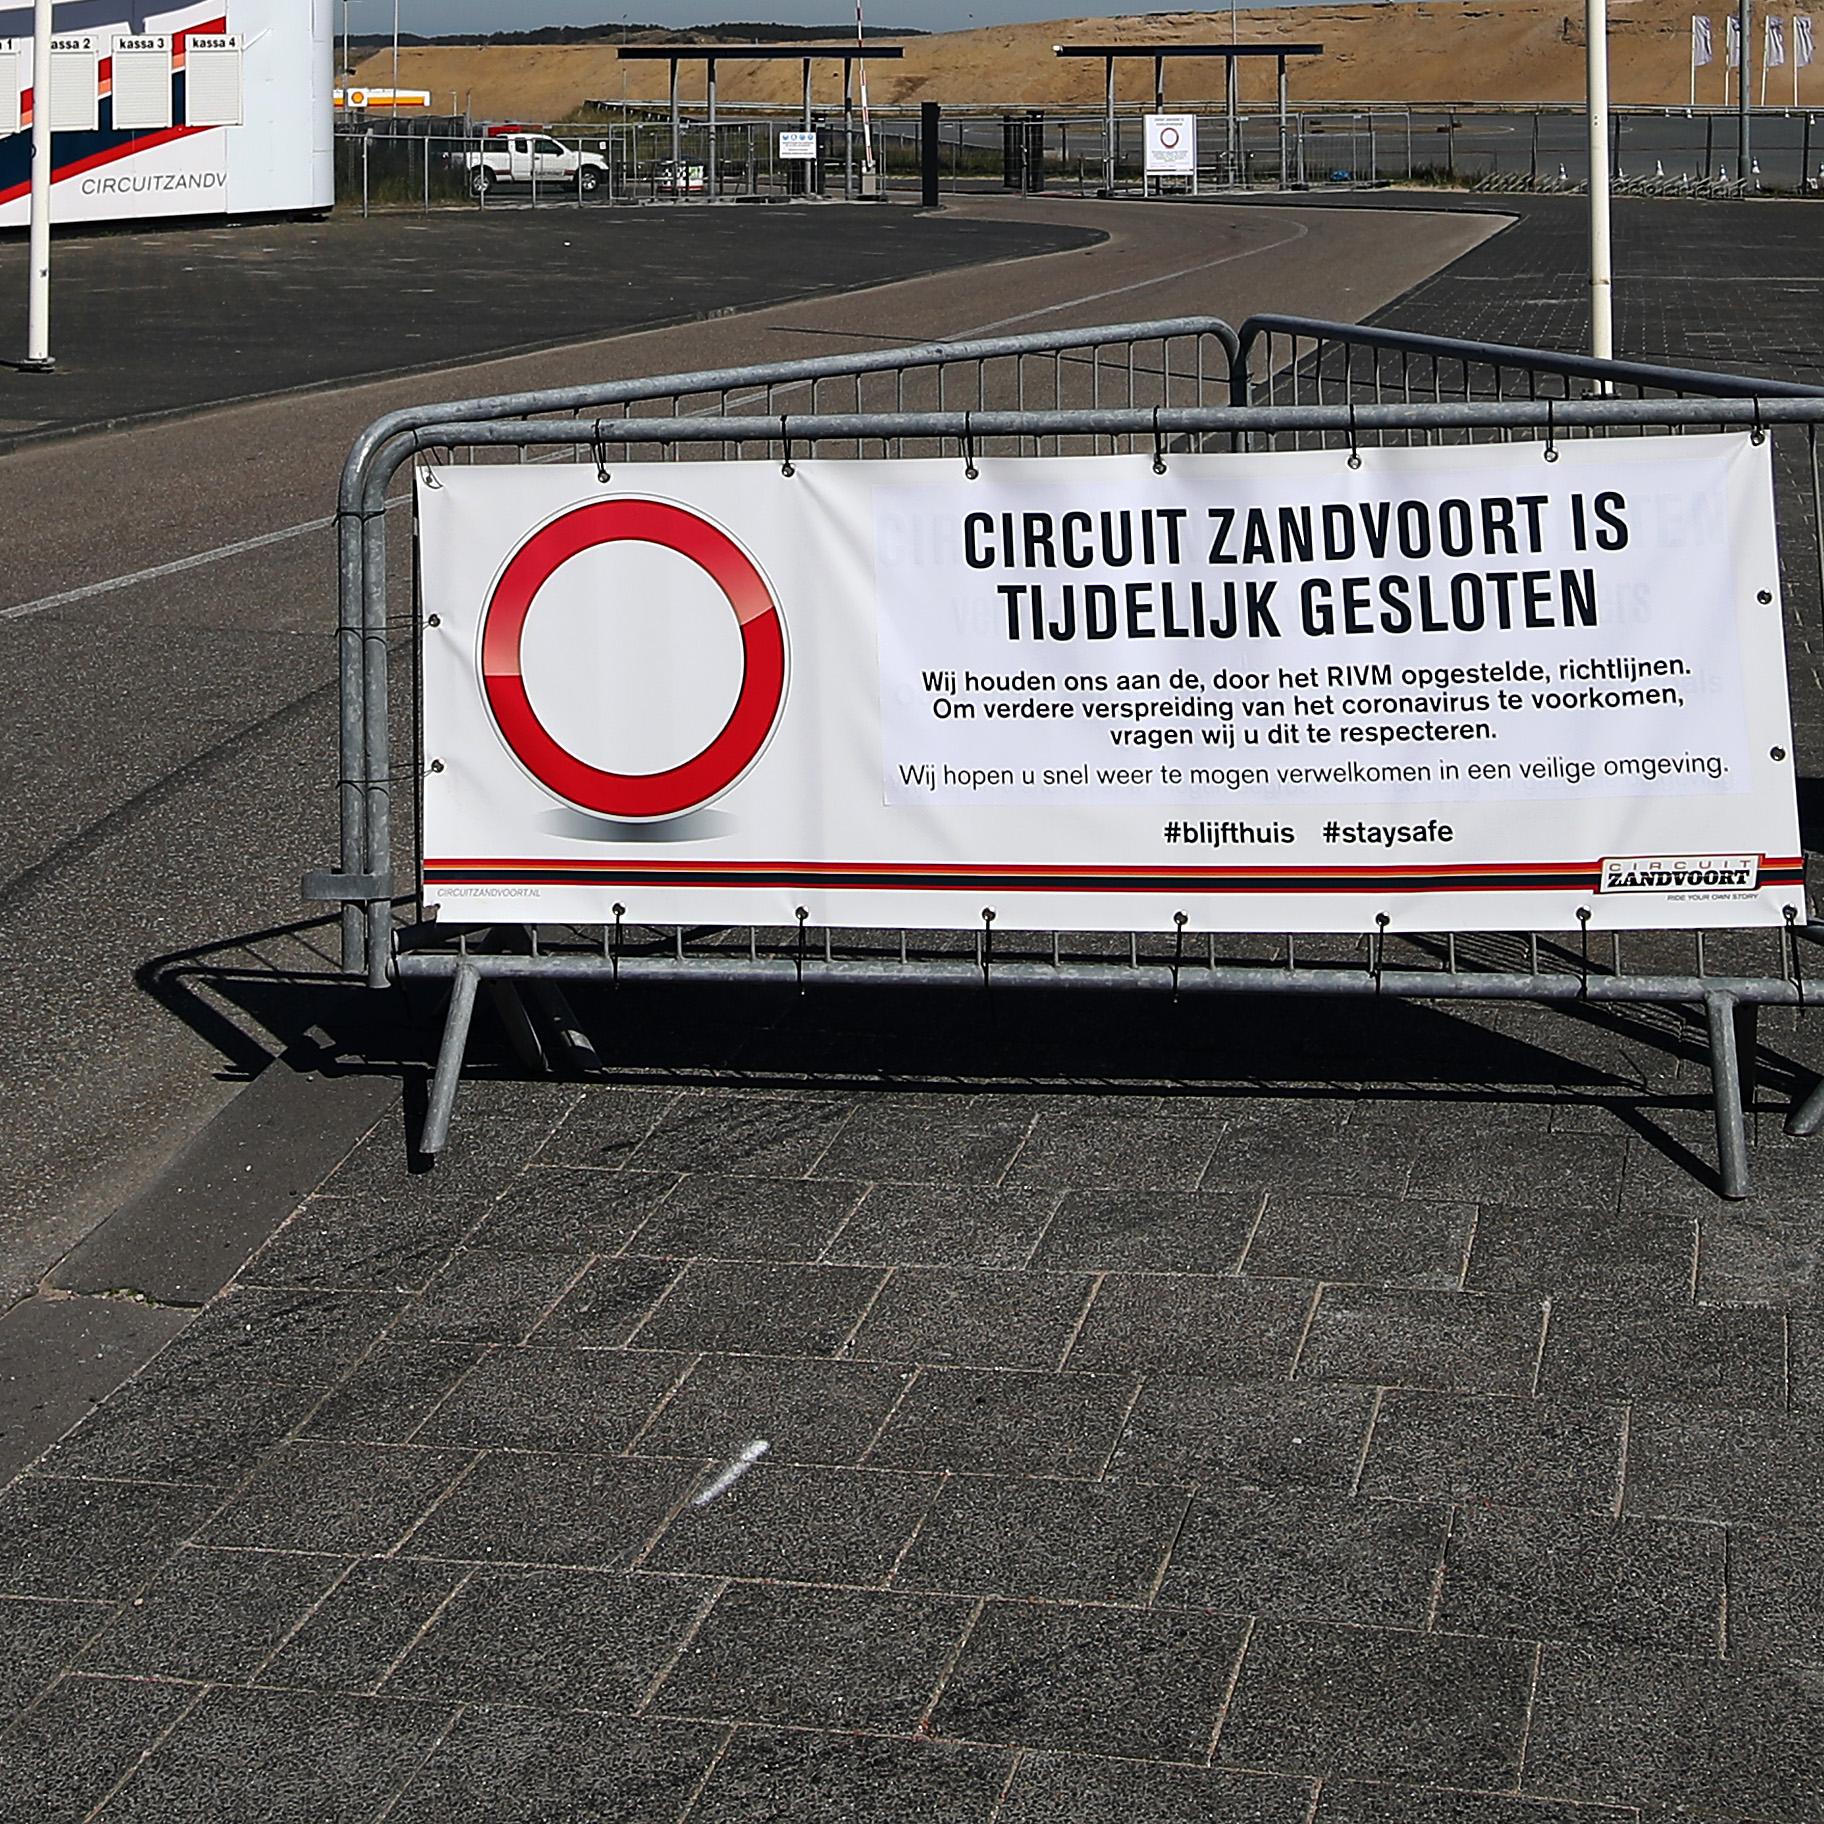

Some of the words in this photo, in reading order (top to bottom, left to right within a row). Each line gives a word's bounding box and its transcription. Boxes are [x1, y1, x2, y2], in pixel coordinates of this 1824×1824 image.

[7, 40, 12, 50] 1
[50, 40, 80, 49] assa
[85, 38, 90, 49] 2
[120, 38, 154, 48] kassa
[158, 38, 164, 48] 3
[193, 38, 225, 48] kassa
[229, 38, 236, 47] 4
[965, 509, 1186, 568] CIRCUIT
[1209, 496, 1548, 564] ZANDVOORT
[1572, 492, 1628, 550] IS
[997, 582, 1281, 641] TIJDELIJK
[1301, 569, 1597, 636] GESLOTEN
[922, 672, 955, 695] Wij
[966, 671, 1055, 691] houden
[1065, 676, 1107, 691] ons
[1117, 675, 1160, 690] aan
[1170, 669, 1204, 693] de,
[1214, 669, 1269, 689] door
[1279, 668, 1318, 688] het
[1328, 665, 1391, 686] RIVM
[1402, 660, 1550, 689] opgestelde,
[1560, 658, 1690, 684] richtlijnen.
[934, 698, 974, 718] Om
[984, 698, 1073, 718] verdere
[1082, 697, 1233, 721] verspreiding
[1242, 702, 1284, 716] van
[1294, 695, 1334, 715] het
[1343, 692, 1489, 714] coronavirus
[1498, 690, 1522, 709] te
[1532, 687, 1683, 708] voorkomen,
[1110, 729, 1192, 749] vragen
[1202, 724, 1234, 748] wij
[1245, 730, 1258, 744] u
[1268, 724, 1299, 744] dit
[1307, 724, 1330, 743] te
[1341, 721, 1496, 745] respecteren.
[899, 765, 935, 791] Wij
[944, 765, 1013, 790] hopen
[1023, 771, 1034, 784] u
[1044, 764, 1088, 784] snel
[1097, 770, 1152, 784] weer
[1161, 766, 1181, 784] te
[1191, 769, 1268, 790] mogen
[1277, 762, 1430, 783] verwelkomen
[1440, 760, 1458, 780] in
[1468, 764, 1510, 779] een
[1519, 757, 1595, 783] veilige
[1605, 752, 1728, 780] omgeving.
[1164, 822, 1294, 848] #blijfthuis
[1323, 820, 1453, 847] #staysafe
[1609, 860, 1751, 870] CIRCUIT
[1607, 869, 1750, 888] ZANDVOORT
[438, 888, 541, 897] CIRCUITZANDVOORT.NL
